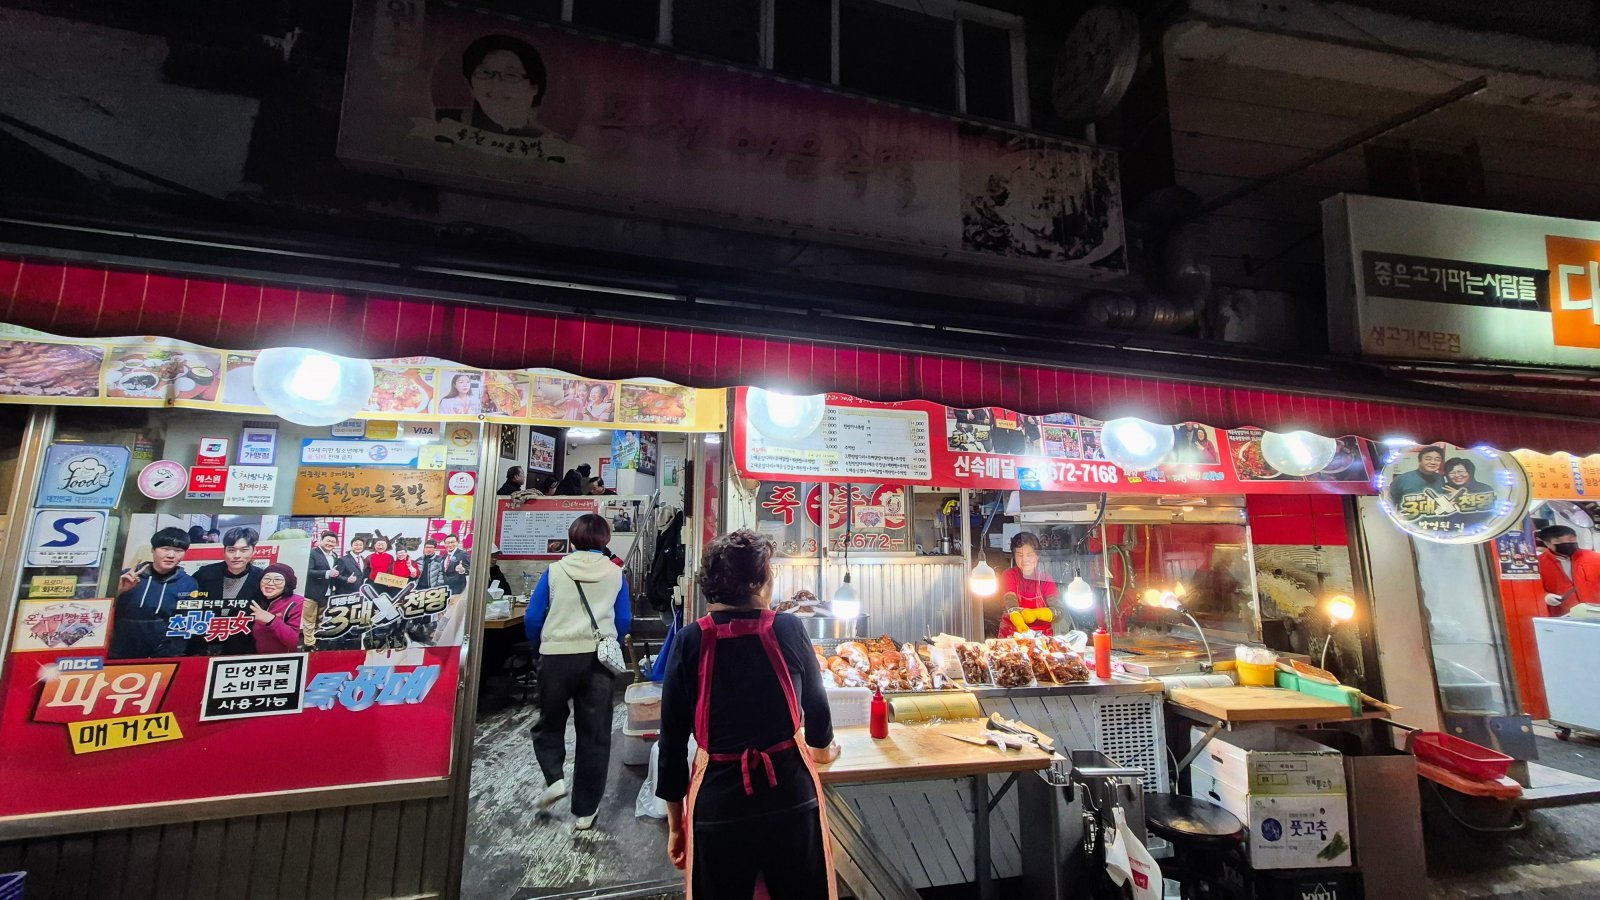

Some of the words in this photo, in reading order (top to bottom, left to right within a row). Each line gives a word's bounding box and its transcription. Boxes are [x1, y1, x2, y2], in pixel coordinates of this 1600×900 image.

[1370, 326, 1461, 354] 생고기전문점
[413, 427, 433, 435] VISA
[953, 456, 1016, 480] 신속배달
[58, 467, 99, 490] food
[195, 474, 221, 483] 에스원
[762, 485, 802, 526] 족
[1401, 499, 1436, 520] 3대
[1418, 520, 1451, 531] 방영된
[1453, 522, 1465, 534] 집
[41, 585, 73, 593] 화재안심
[203, 600, 224, 609] 덕력
[227, 599, 249, 608] 자랑
[315, 602, 373, 639] 3대
[403, 587, 450, 618] 천왕
[25, 612, 104, 626] 온누리상품권
[58, 658, 99, 671] MBC
[224, 663, 291, 679] 민생회복
[46, 671, 162, 716] 파워
[221, 678, 289, 694] 소비쿠폰
[304, 664, 441, 711] 특공대
[217, 696, 289, 711] 사용가능
[79, 715, 171, 746] 매거진
[1289, 819, 1329, 841] 풋고추
